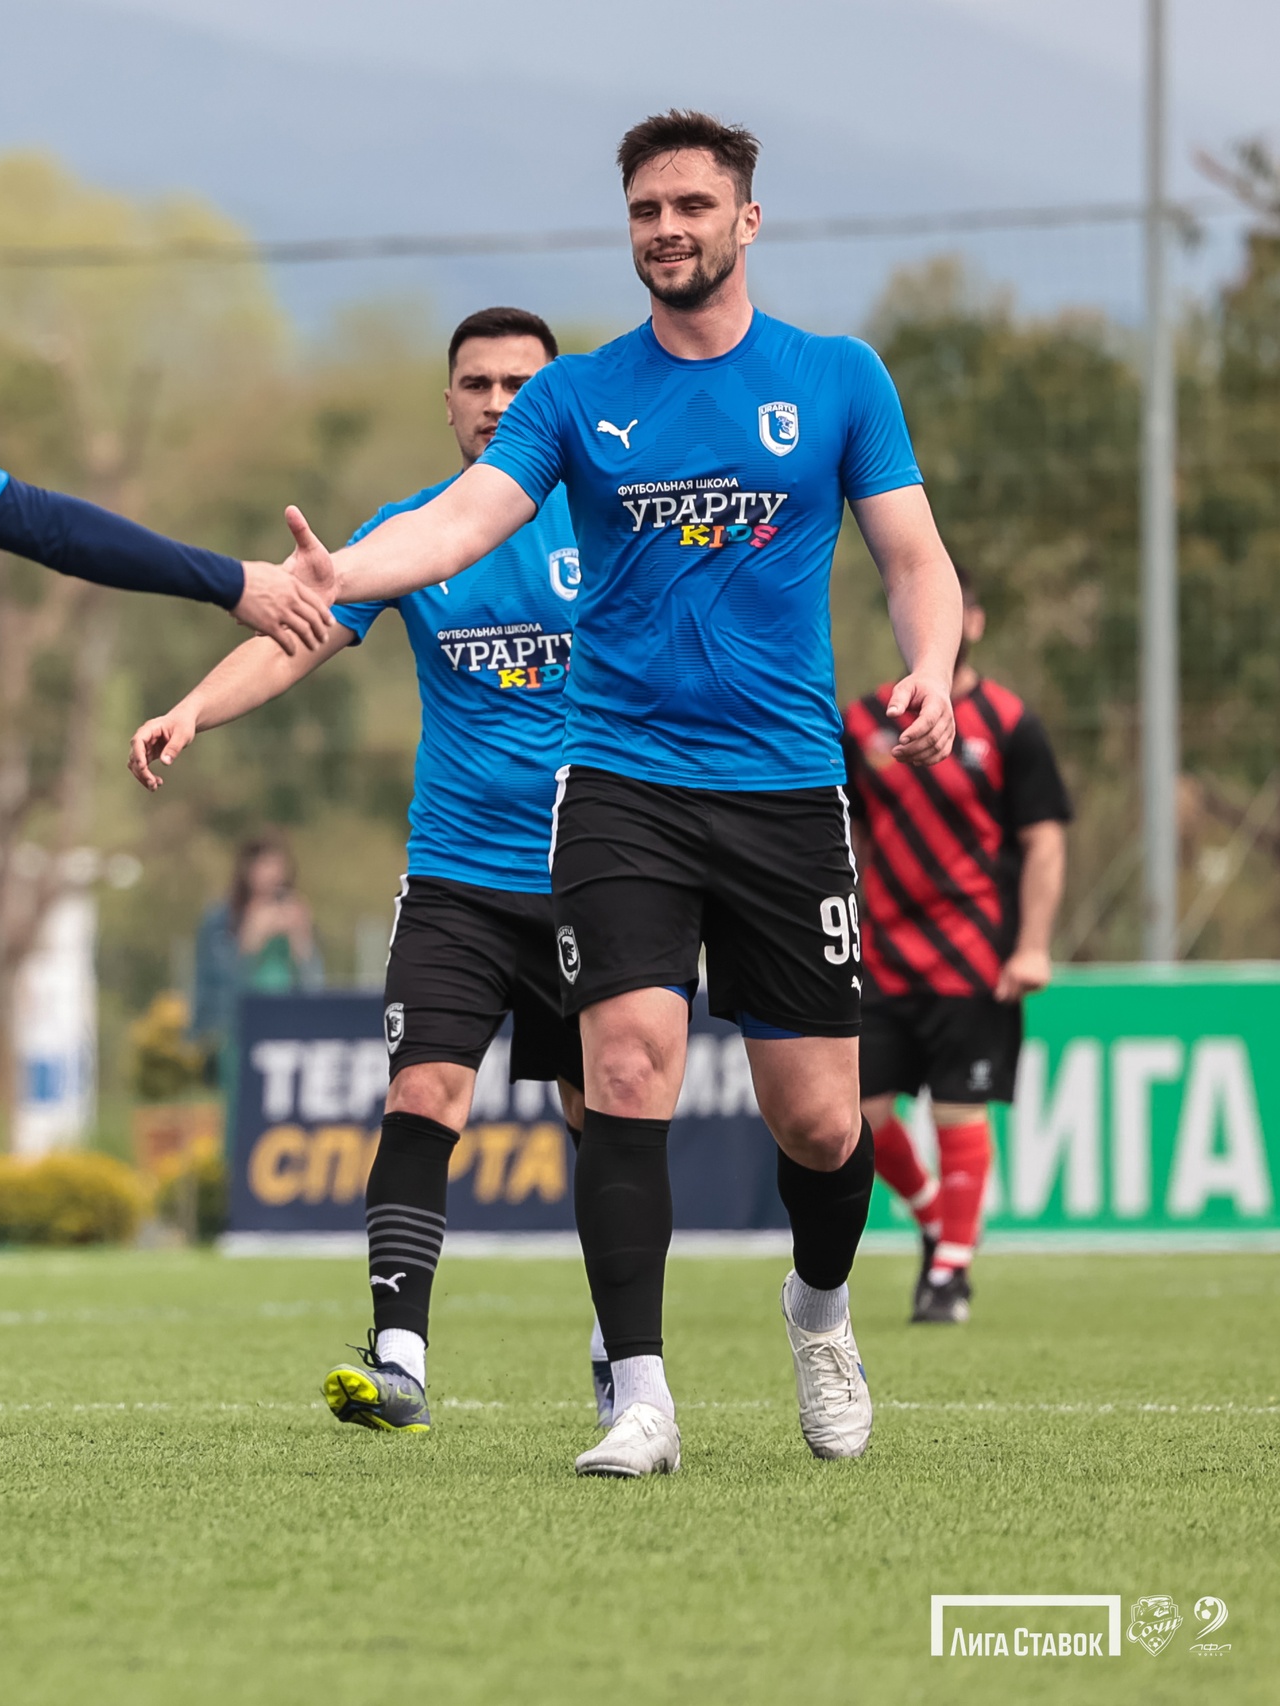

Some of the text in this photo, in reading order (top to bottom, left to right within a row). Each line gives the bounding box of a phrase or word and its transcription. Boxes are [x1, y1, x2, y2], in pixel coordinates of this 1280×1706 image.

[617, 477, 739, 497] ФУТБОЛЬНАЯ ШКОЛА
[622, 492, 788, 532] УРАРТУ
[679, 523, 779, 549] KIDS
[437, 622, 542, 641] ФУТБОЛЬНАЯ ШКОЛА
[497, 663, 571, 689] KID
[820, 893, 860, 965] 99
[248, 1123, 568, 1206] СПТА
